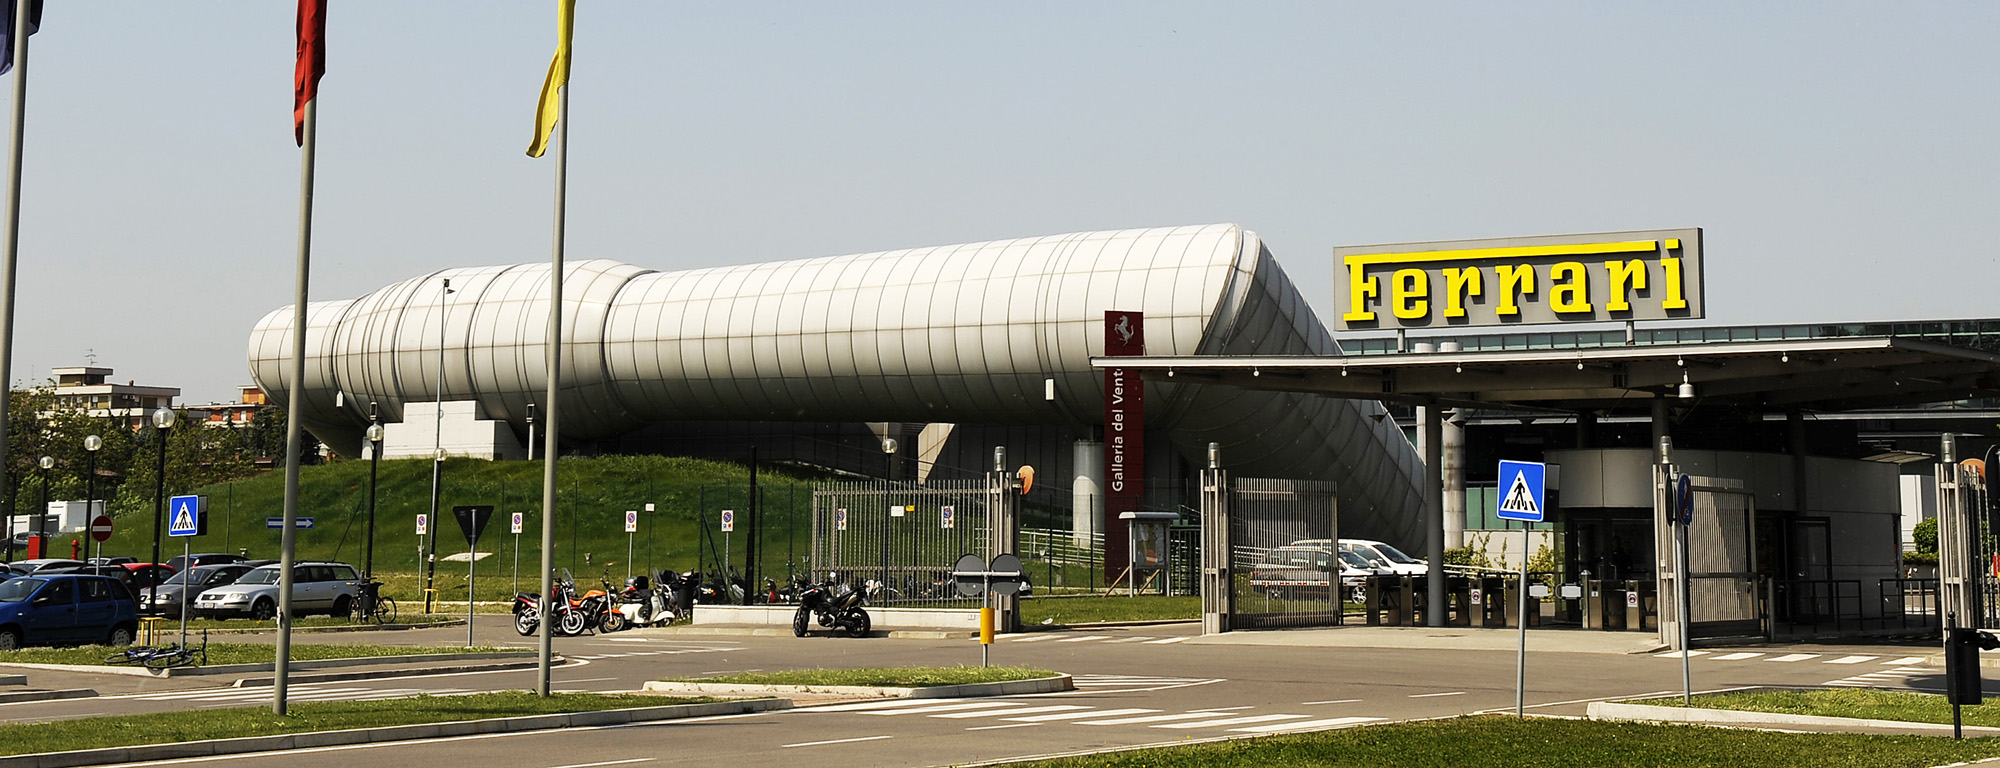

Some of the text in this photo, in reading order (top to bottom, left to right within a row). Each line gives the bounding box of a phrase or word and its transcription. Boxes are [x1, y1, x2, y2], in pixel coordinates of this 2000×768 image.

[1343, 238, 1687, 321] Ferrari
[1111, 368, 1123, 492] Galleria del Vent
